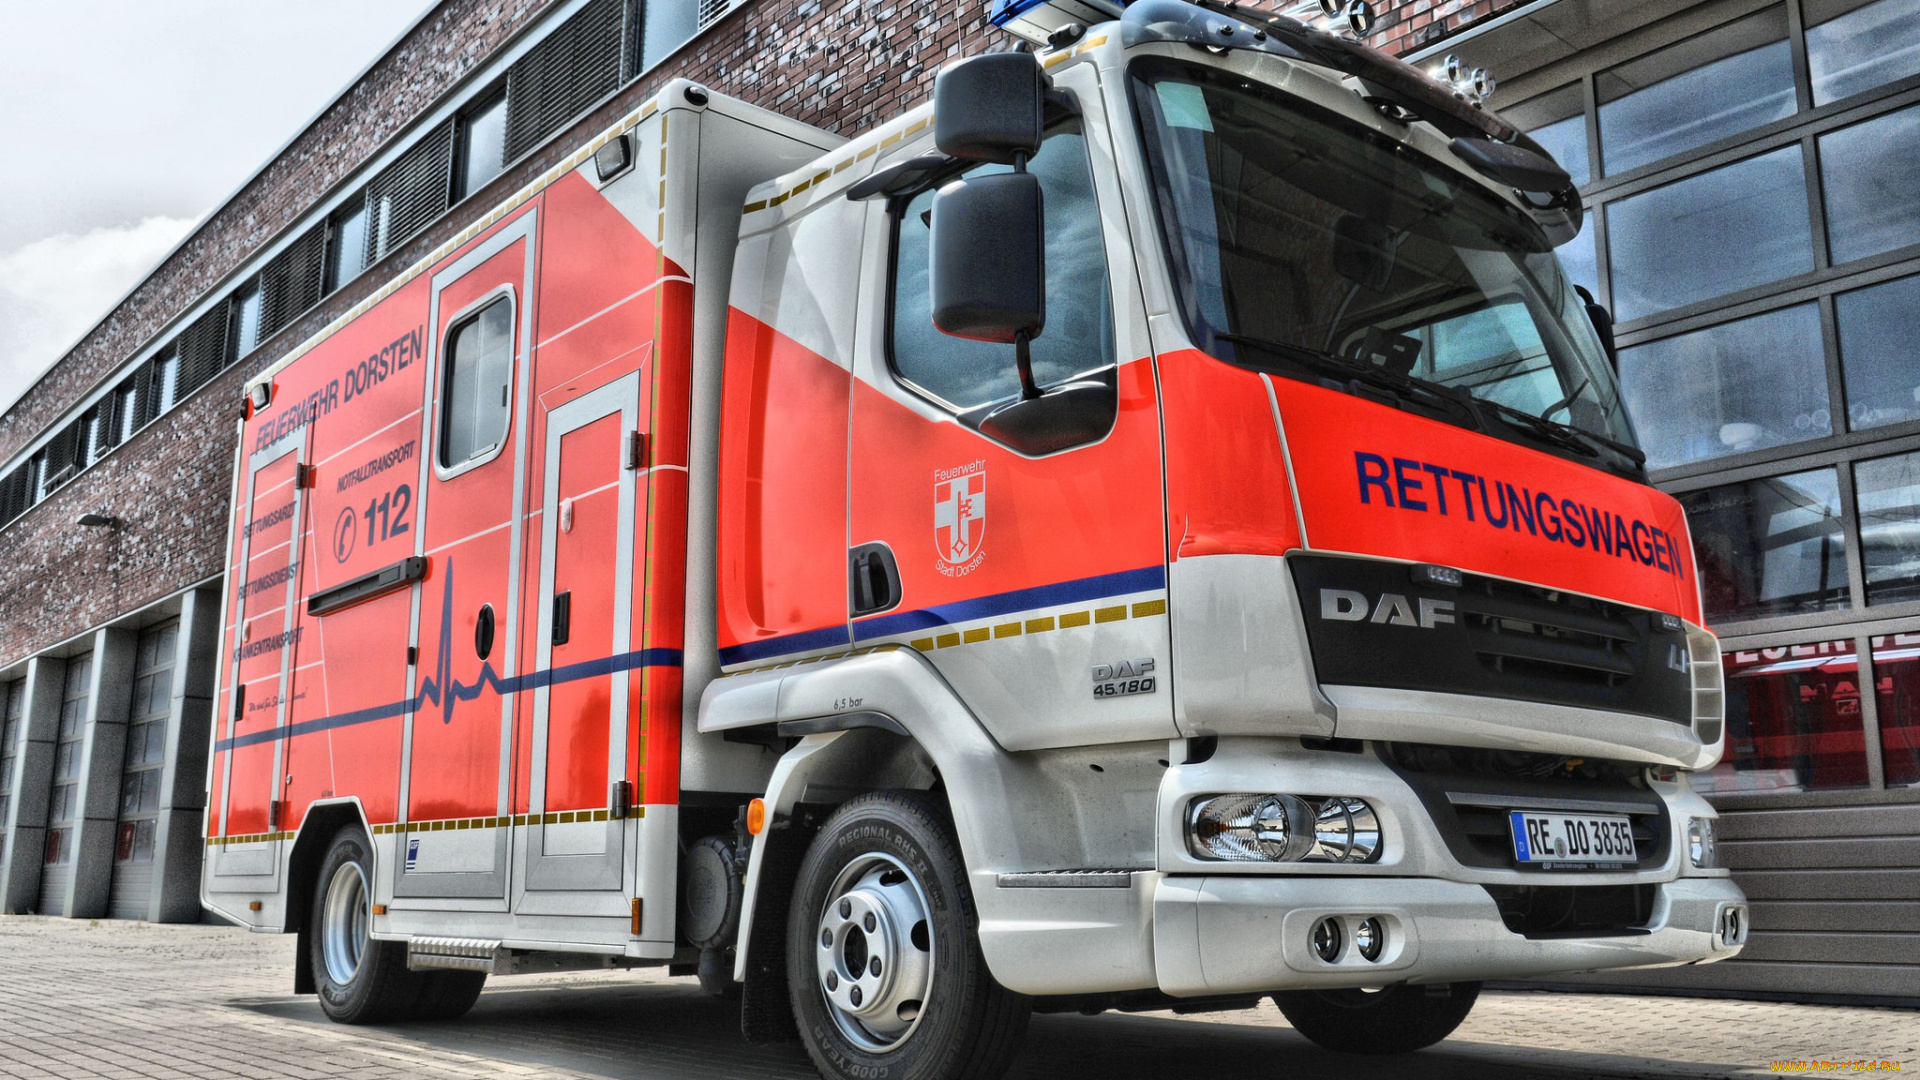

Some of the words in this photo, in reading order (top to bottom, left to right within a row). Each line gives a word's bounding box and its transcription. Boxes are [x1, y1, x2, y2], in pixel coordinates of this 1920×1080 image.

[255, 378, 339, 456] FEUERWEHR
[344, 324, 423, 403] DORSTEN
[336, 439, 416, 494] NOTFALLTRANSPORT
[934, 458, 986, 482] Feuerwehr
[244, 500, 297, 539] RETTUNGSARZT
[364, 484, 411, 547] 112
[1354, 451, 1684, 580] RETTUNGSWAGEN
[237, 561, 300, 600] RETTUNGSDIENST
[935, 559, 955, 577] Stadt
[956, 551, 987, 577] Dorsten
[1320, 588, 1456, 629] DAF
[1092, 657, 1155, 681] DAF
[1093, 678, 1153, 697] 45.180
[833, 698, 847, 711] 6,5
[849, 696, 863, 708] bar
[839, 825, 892, 848] REGIONAL
[1526, 819, 1555, 855] RE
[1564, 820, 1589, 855] DO
[1590, 821, 1633, 856] 3835
